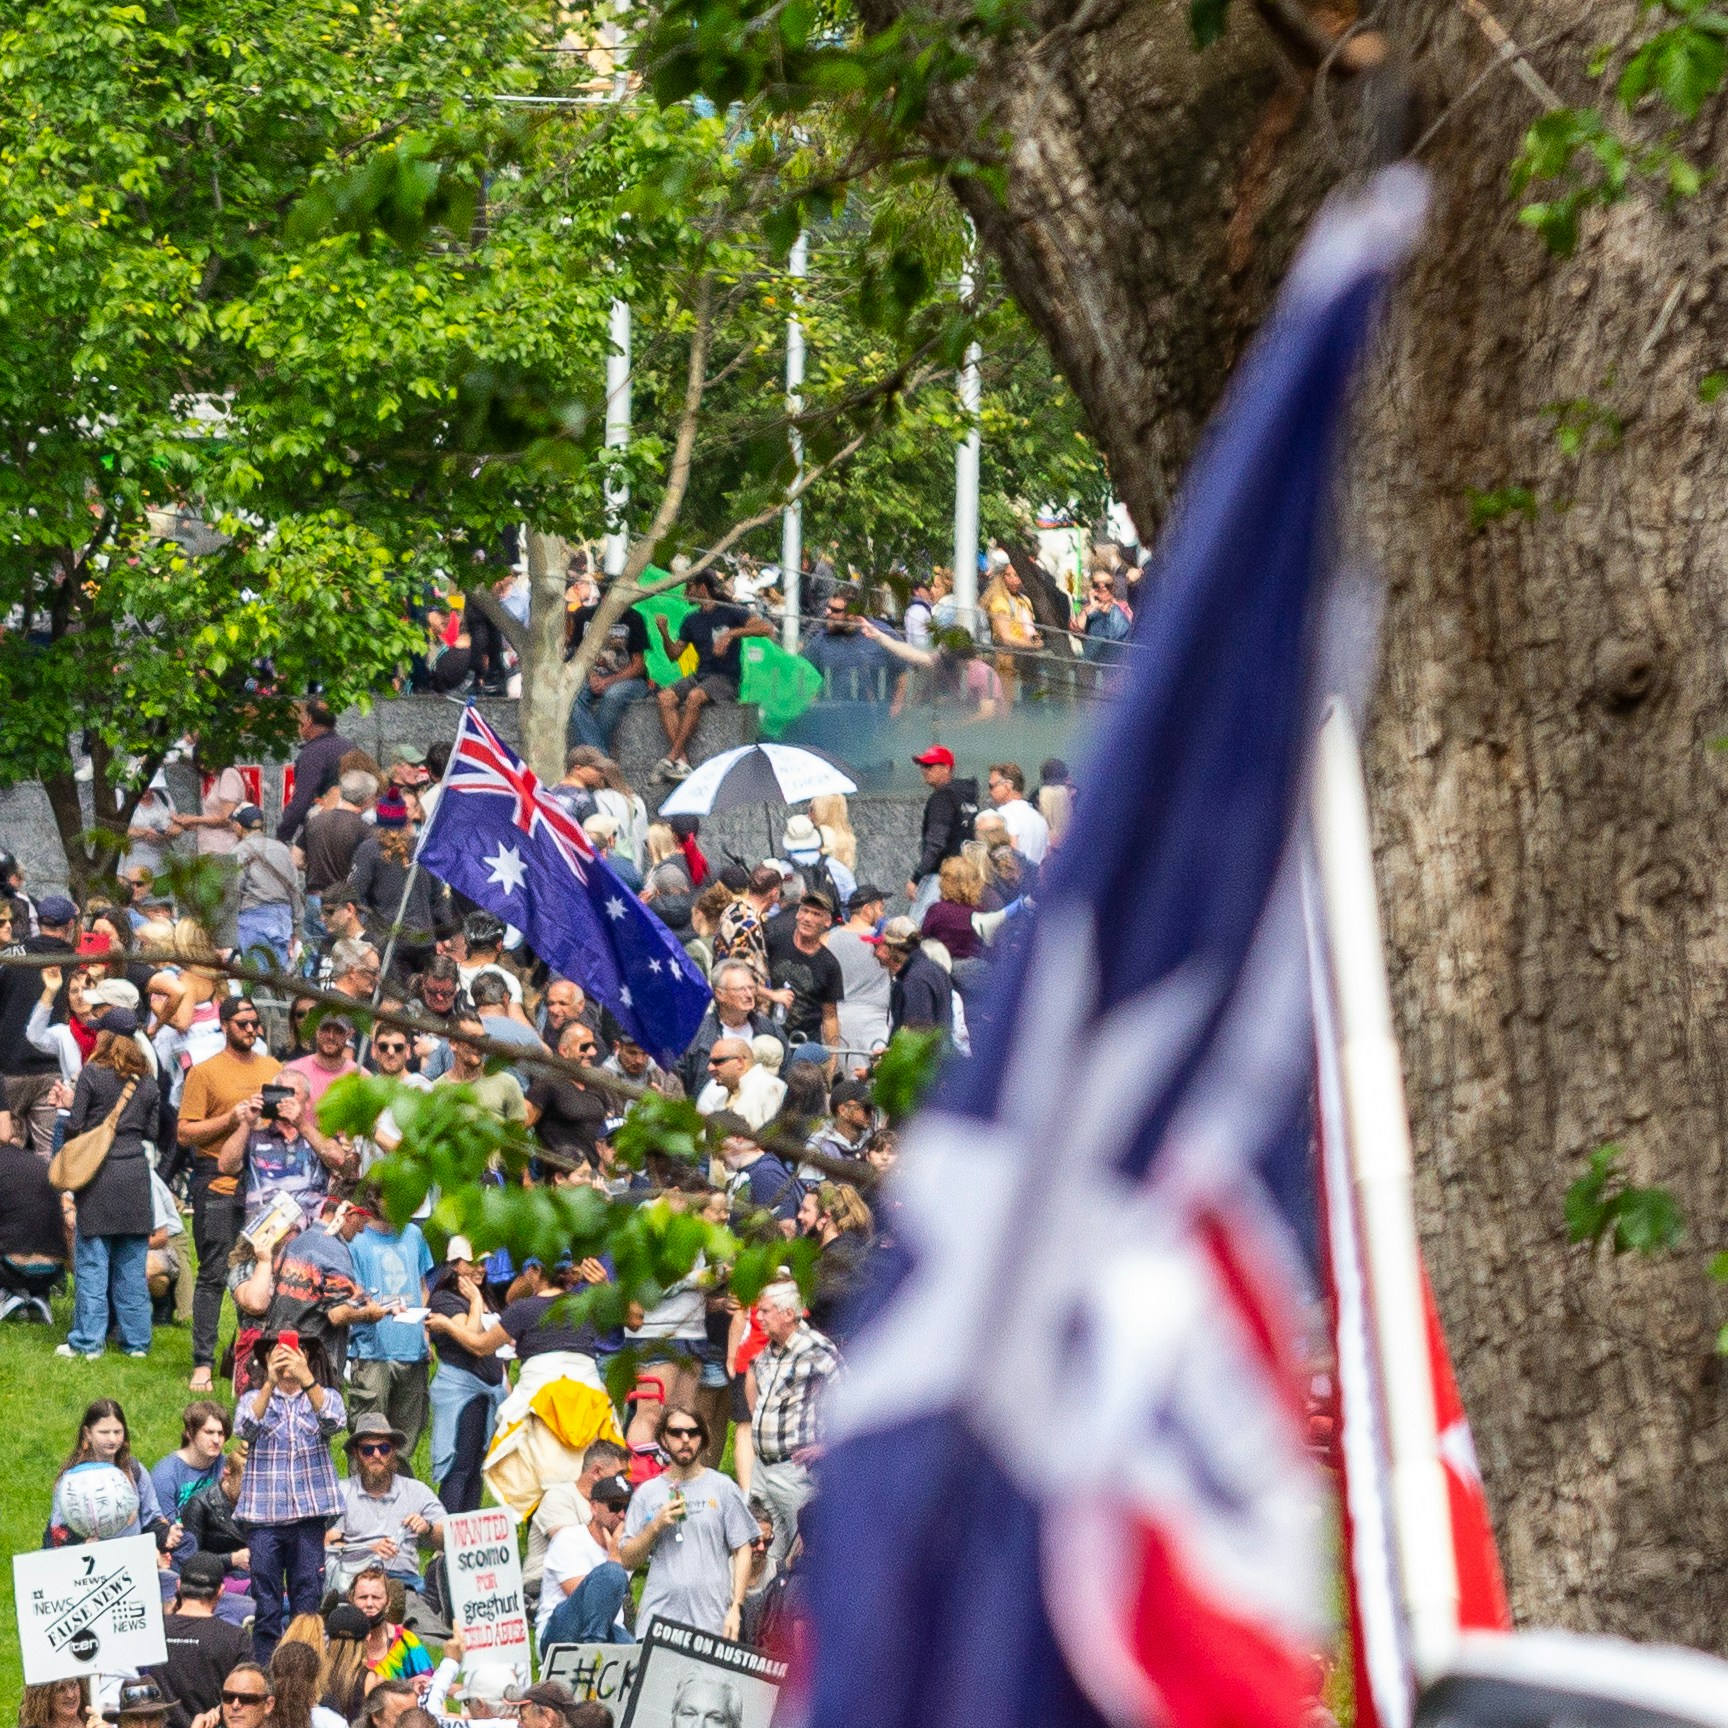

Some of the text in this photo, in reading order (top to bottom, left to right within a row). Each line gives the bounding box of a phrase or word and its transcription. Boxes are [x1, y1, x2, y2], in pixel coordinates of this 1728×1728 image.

[449, 1513, 510, 1548] WANTED
[73, 1575, 108, 1588] NEWS
[475, 1572, 499, 1593] FOR
[33, 1596, 75, 1617] NEWS
[47, 1570, 133, 1648] FALSE NEWS
[113, 1618, 147, 1634] NEWS
[494, 1618, 526, 1648] ABUSE
[71, 1639, 99, 1653] ten
[651, 1620, 691, 1648] COME
[693, 1634, 714, 1657] ON
